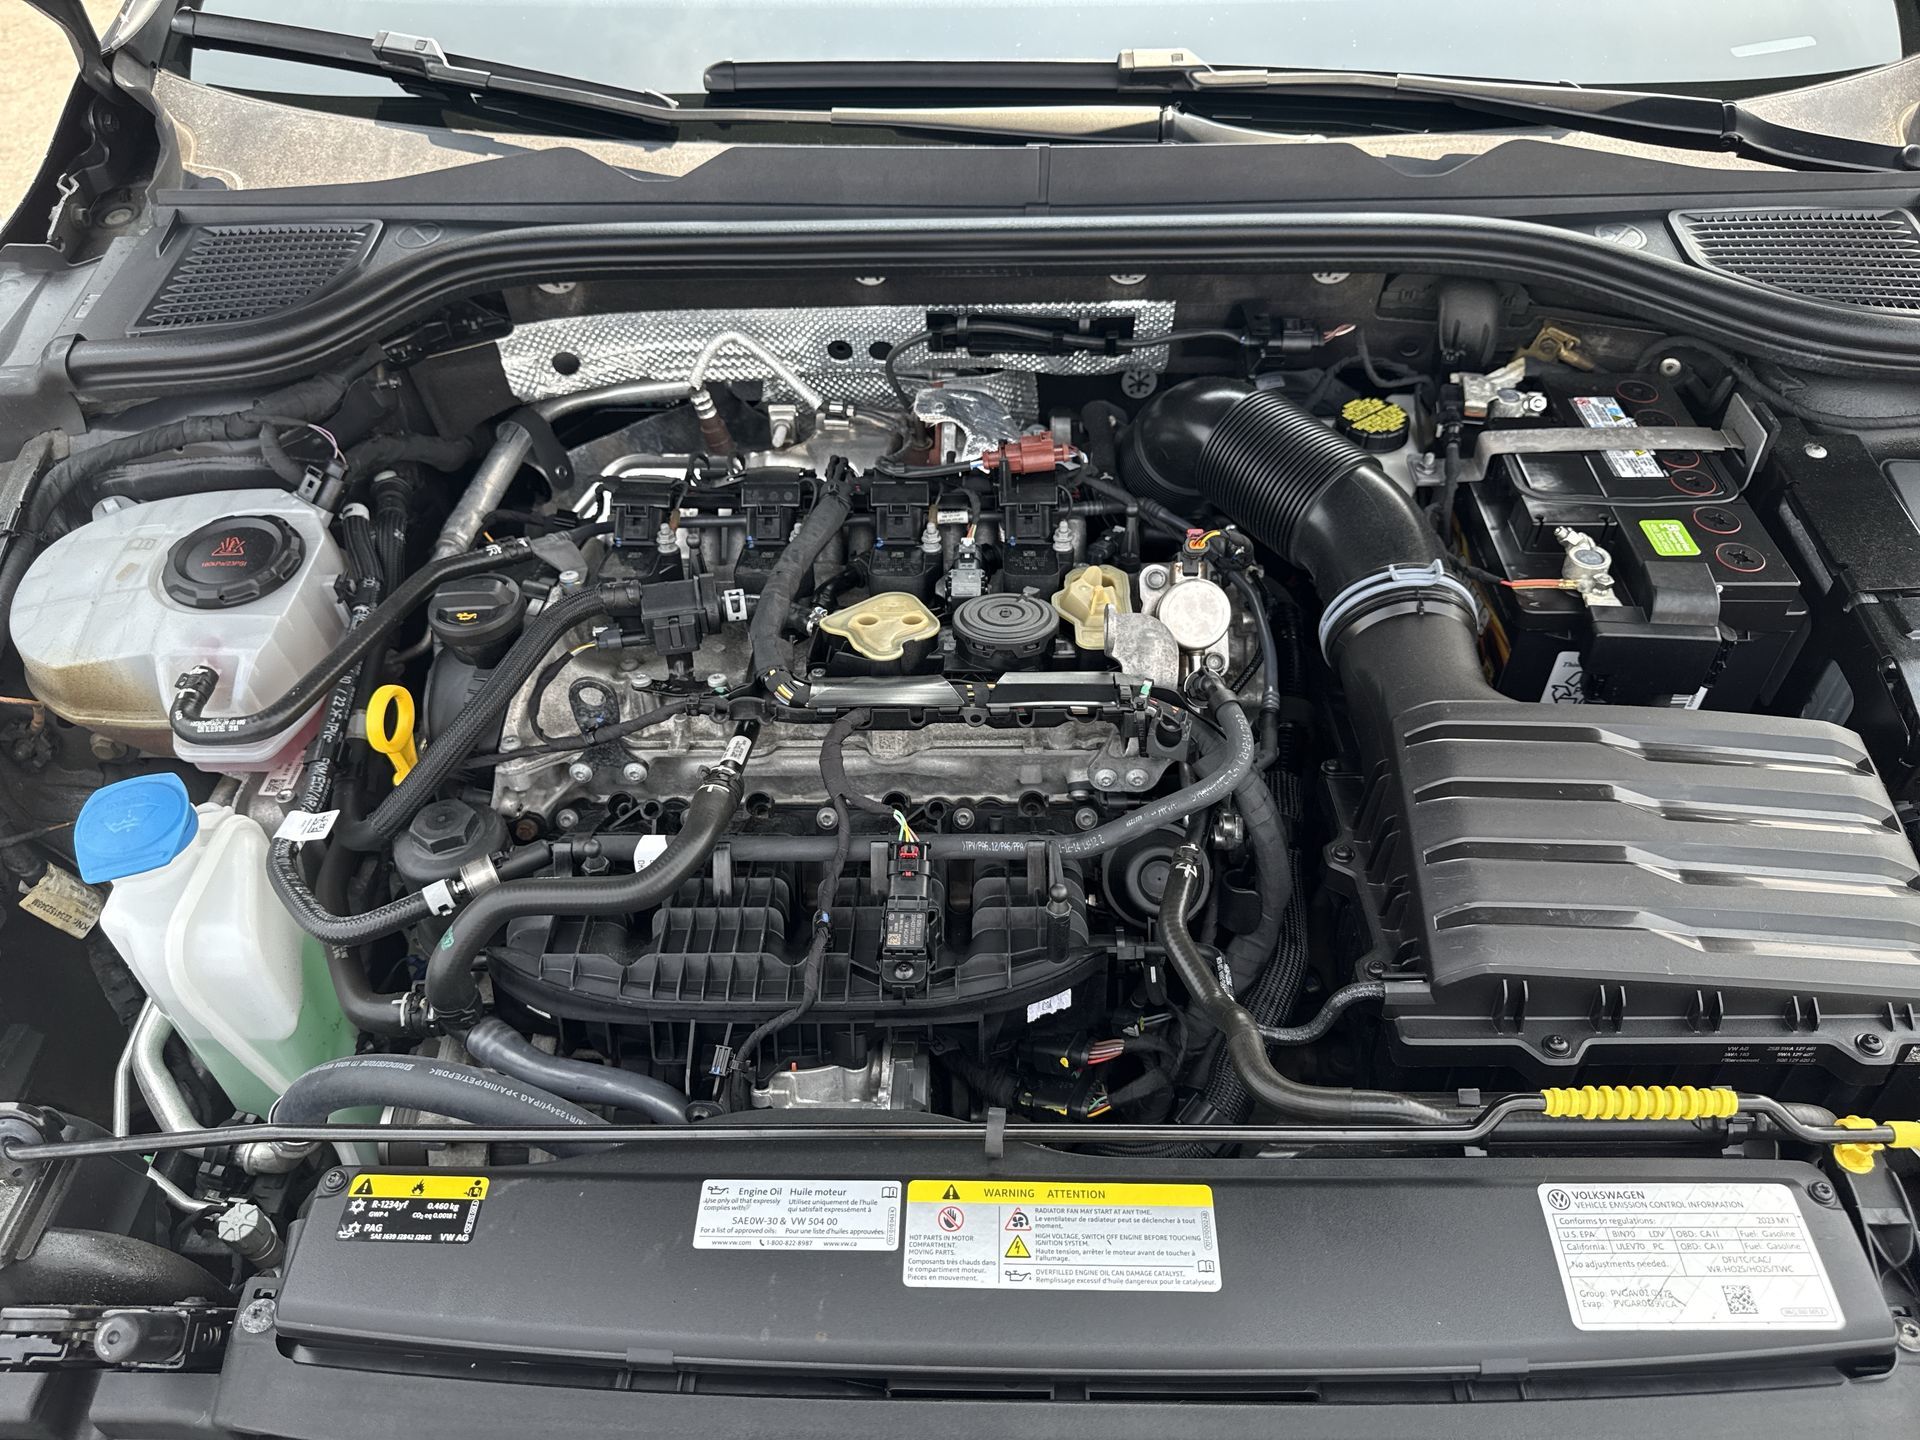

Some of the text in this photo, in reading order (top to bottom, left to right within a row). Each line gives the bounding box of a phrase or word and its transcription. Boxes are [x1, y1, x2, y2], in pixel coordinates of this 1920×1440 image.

[739, 1188, 768, 1197] Engine
[790, 1188, 812, 1196] Huile
[984, 1189, 1105, 1199] WARNING ATTENTION
[1571, 1191, 1645, 1199] VOLKSWAGEN
[372, 1200, 409, 1211] R-1234yf
[450, 1203, 459, 1211] kg
[780, 1217, 786, 1225] &
[791, 1217, 806, 1225] VW
[1609, 1218, 1656, 1226] regulations:
[363, 1224, 382, 1232] PAG
[1586, 1261, 1635, 1270] adjustments
